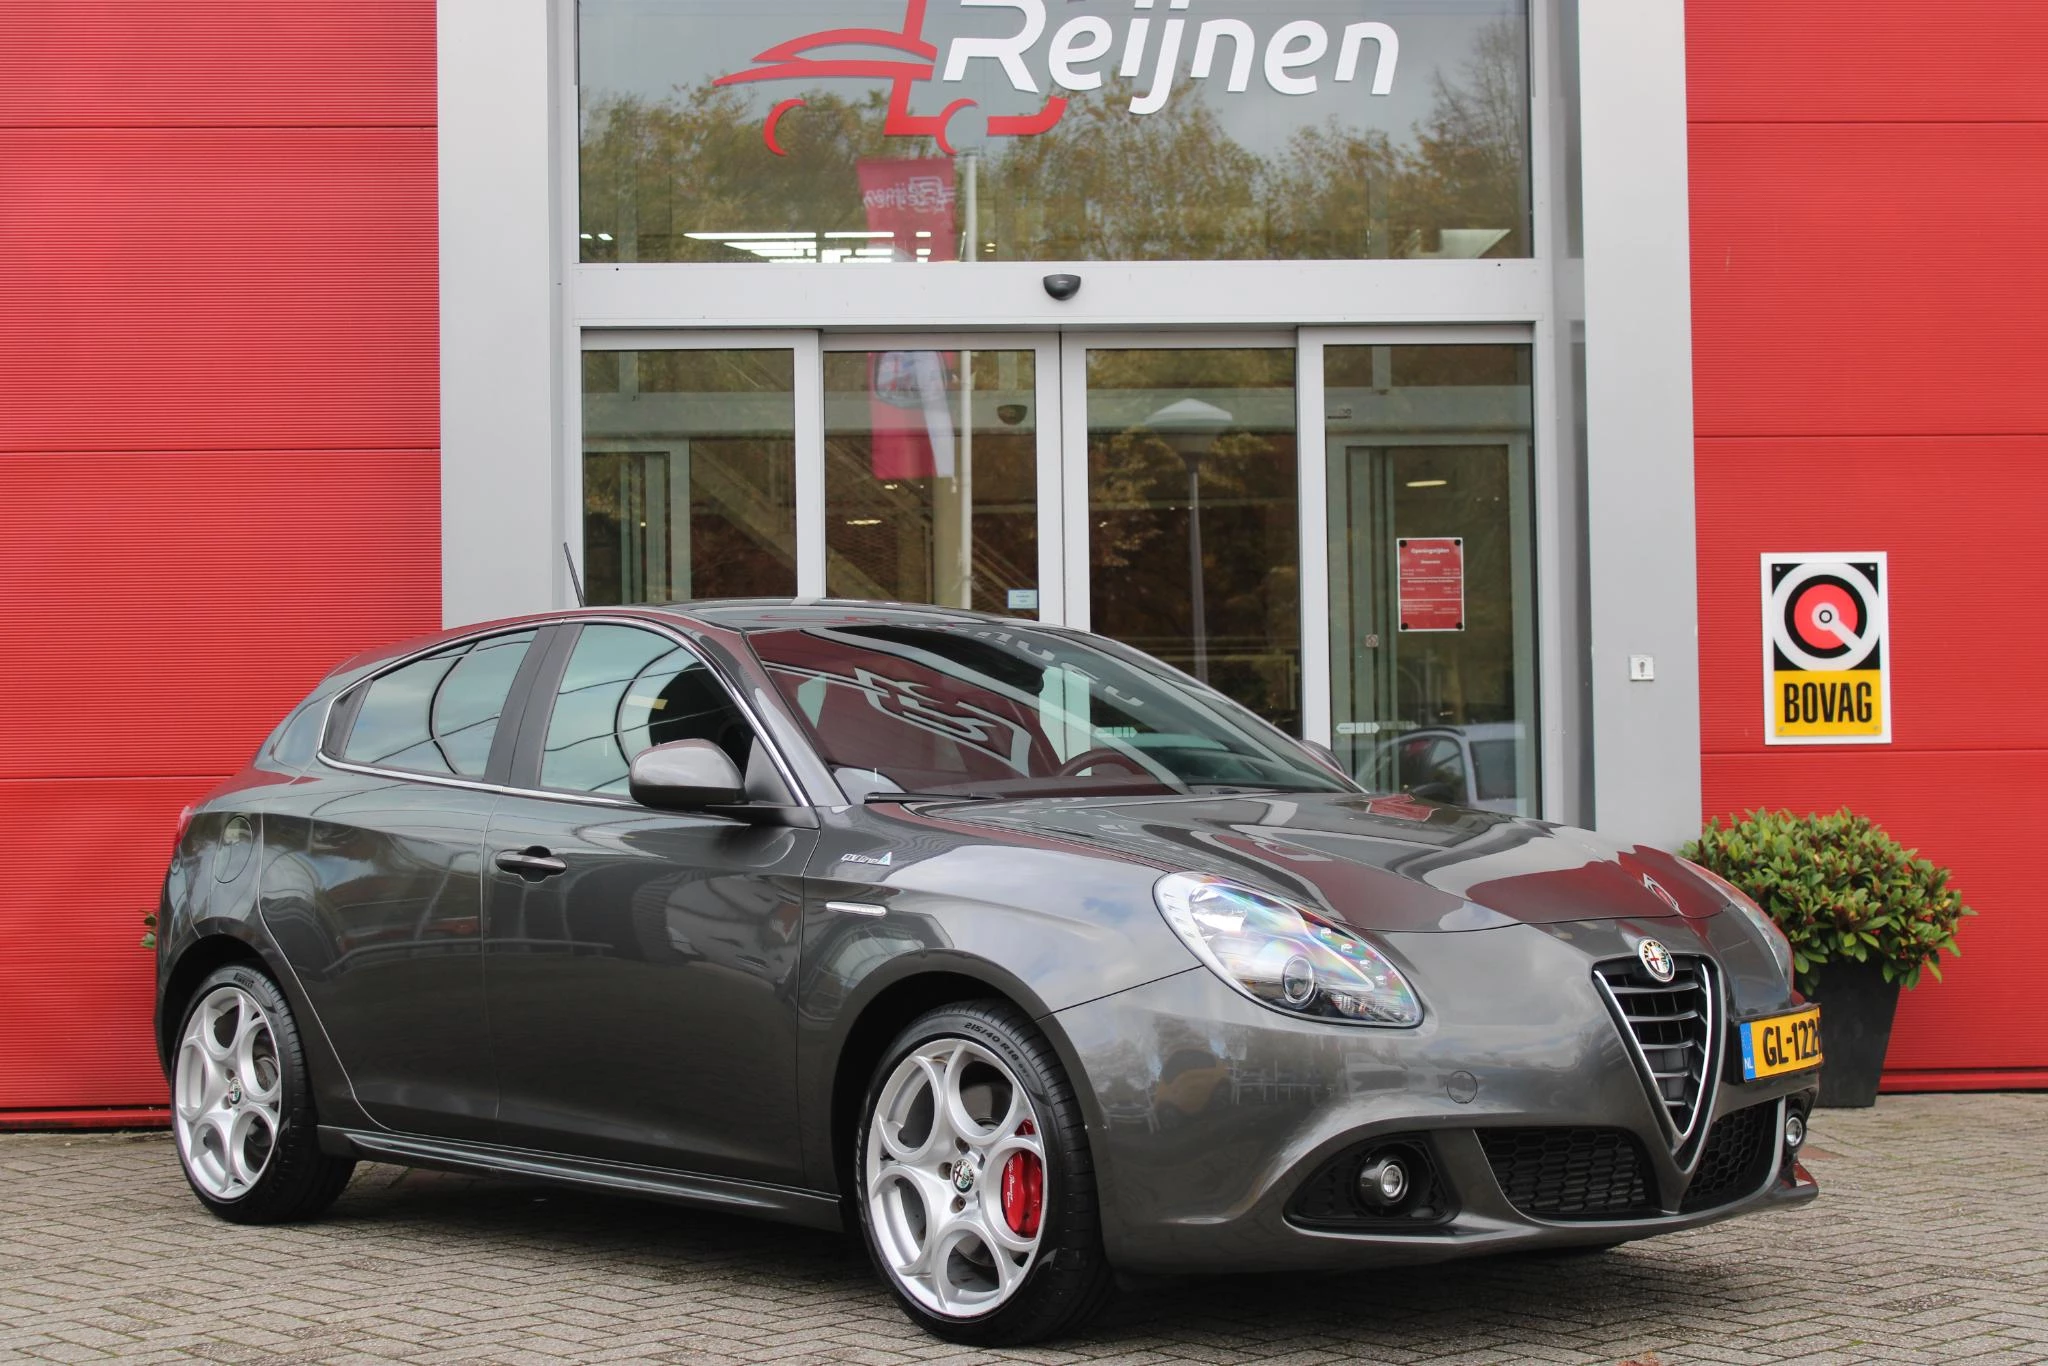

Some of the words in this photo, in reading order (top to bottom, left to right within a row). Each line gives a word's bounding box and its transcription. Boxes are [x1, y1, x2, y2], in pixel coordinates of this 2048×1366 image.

[943, 0, 1400, 115] Reijnen
[1783, 682, 1873, 723] BOVAG
[963, 1022, 1001, 1043] 215/40
[1000, 1043, 1020, 1061] R18
[1744, 1057, 1754, 1070] NL
